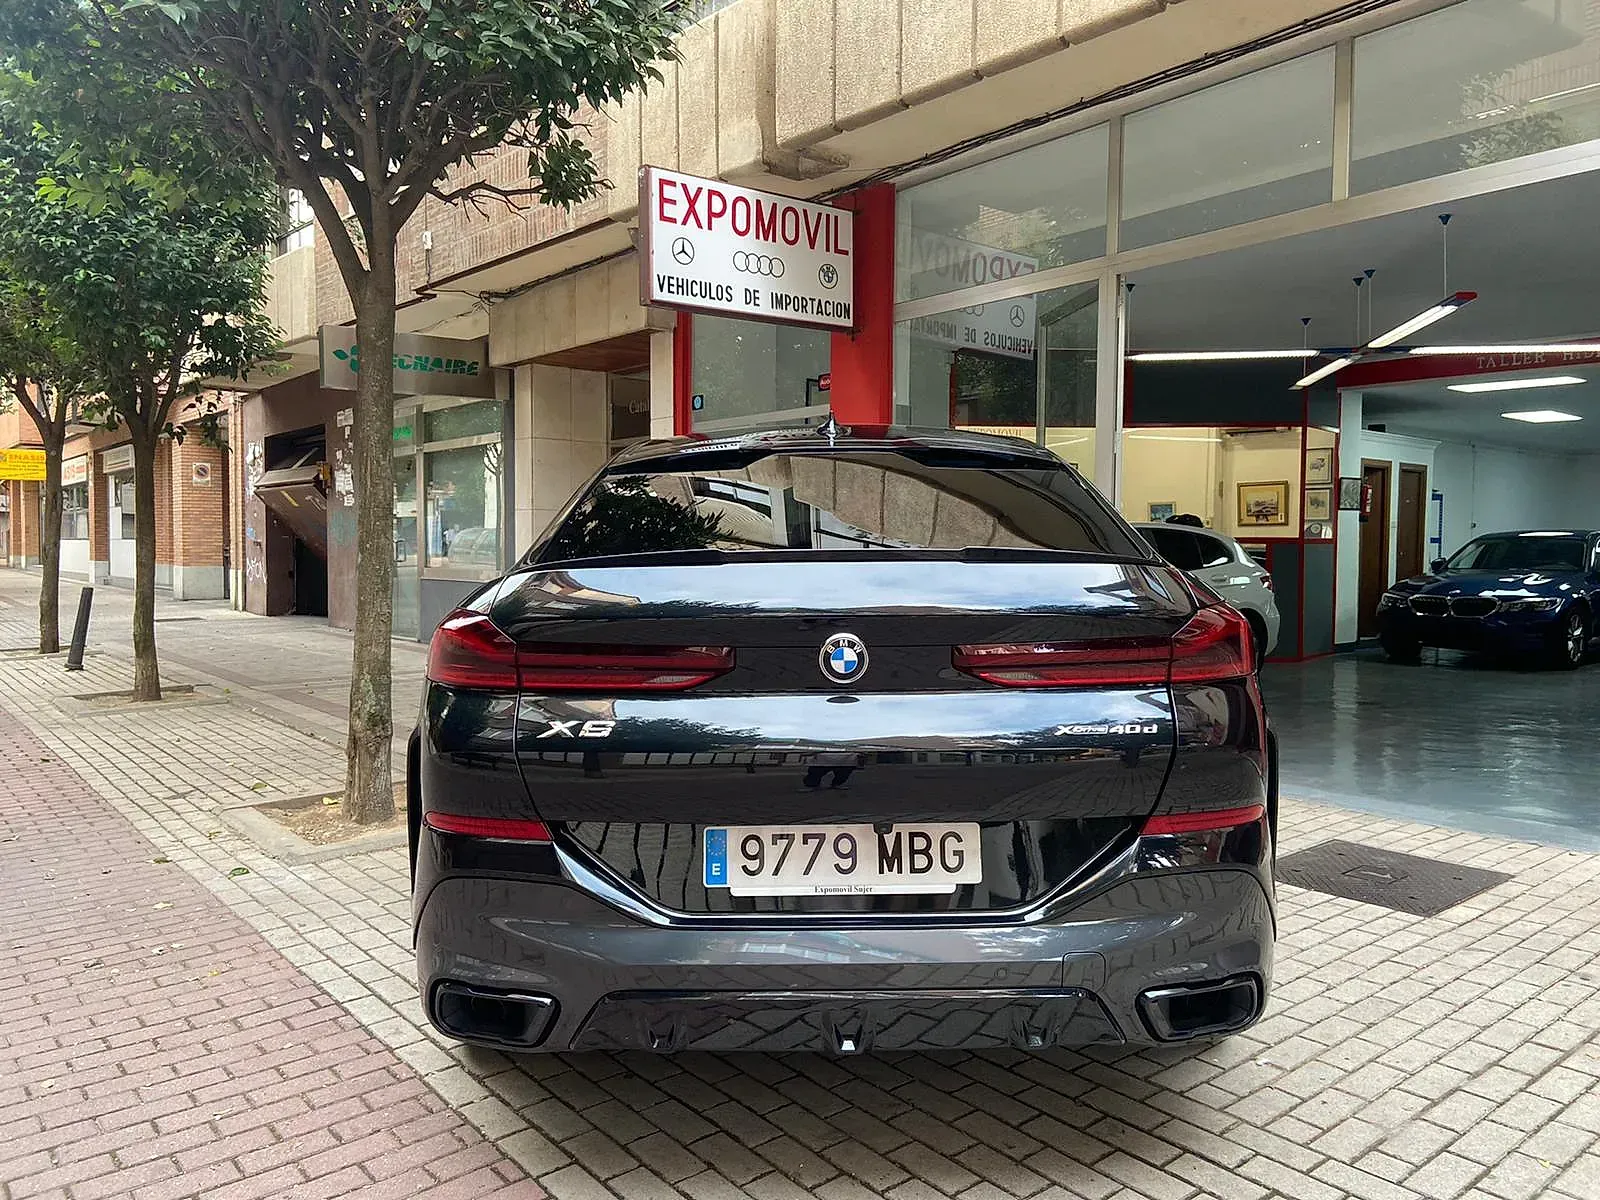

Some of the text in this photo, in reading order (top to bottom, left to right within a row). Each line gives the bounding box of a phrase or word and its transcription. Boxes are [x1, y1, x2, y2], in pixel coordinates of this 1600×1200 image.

[658, 178, 850, 256] EXPOMOVIL
[656, 274, 851, 320] VEHICULOS DE IMPORTACION
[392, 354, 480, 377] ECNAIRE
[1476, 352, 1546, 369] TALLER
[536, 720, 617, 739] X6
[711, 831, 966, 877] E 9779 MBG
